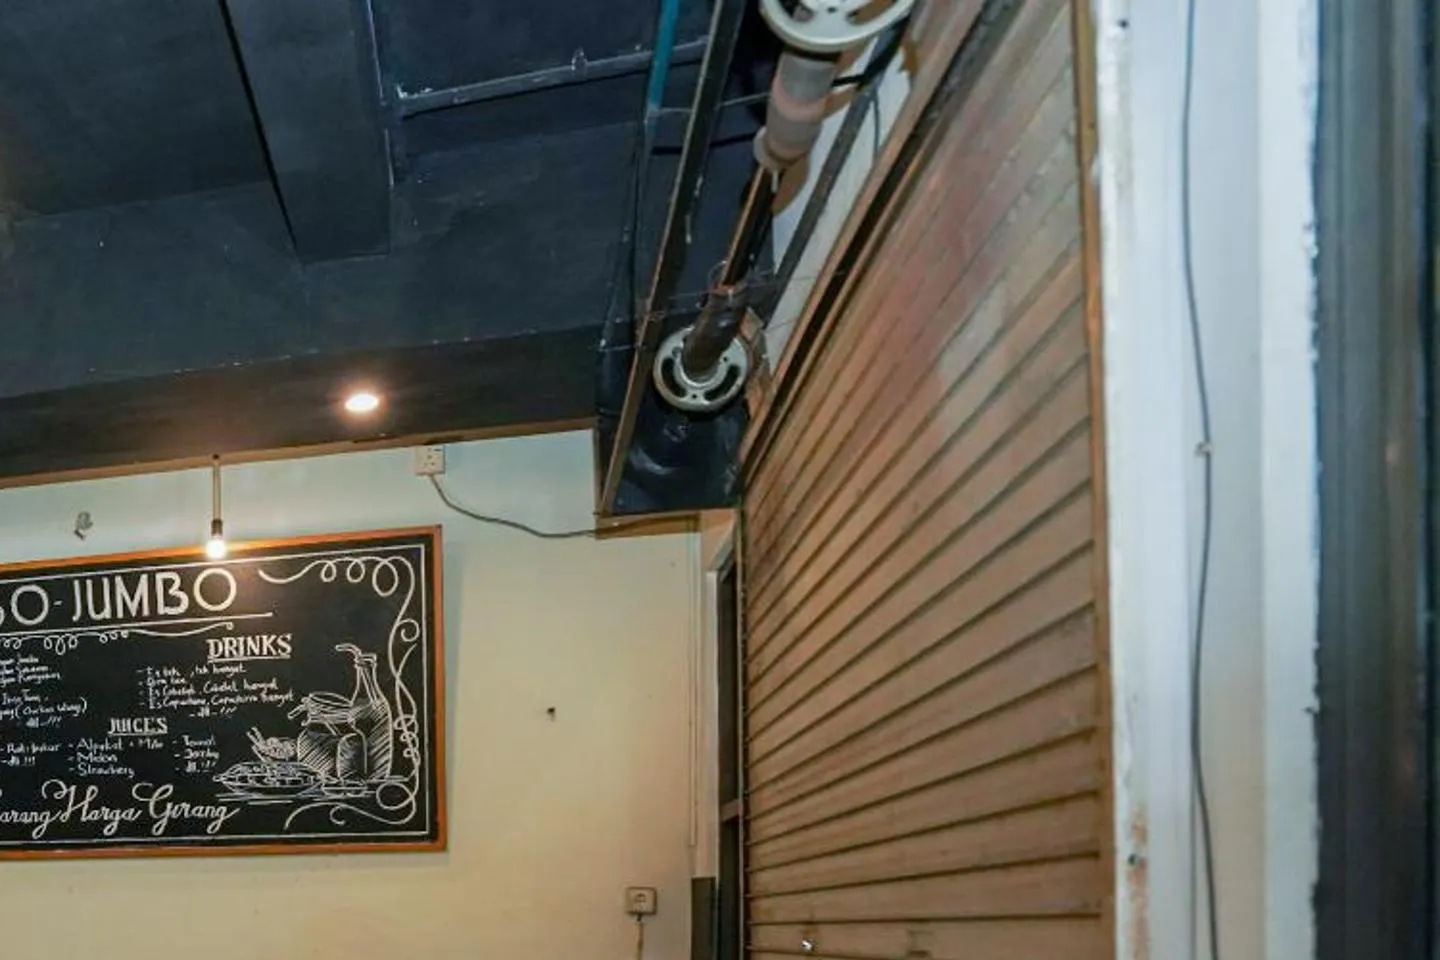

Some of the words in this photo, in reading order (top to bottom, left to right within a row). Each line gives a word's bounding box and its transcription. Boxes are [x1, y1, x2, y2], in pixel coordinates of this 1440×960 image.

[206, 633, 293, 659] DRINKS
[108, 716, 168, 735] JUICES
[76, 751, 118, 763] Melon
[41, 779, 143, 837] Harga
